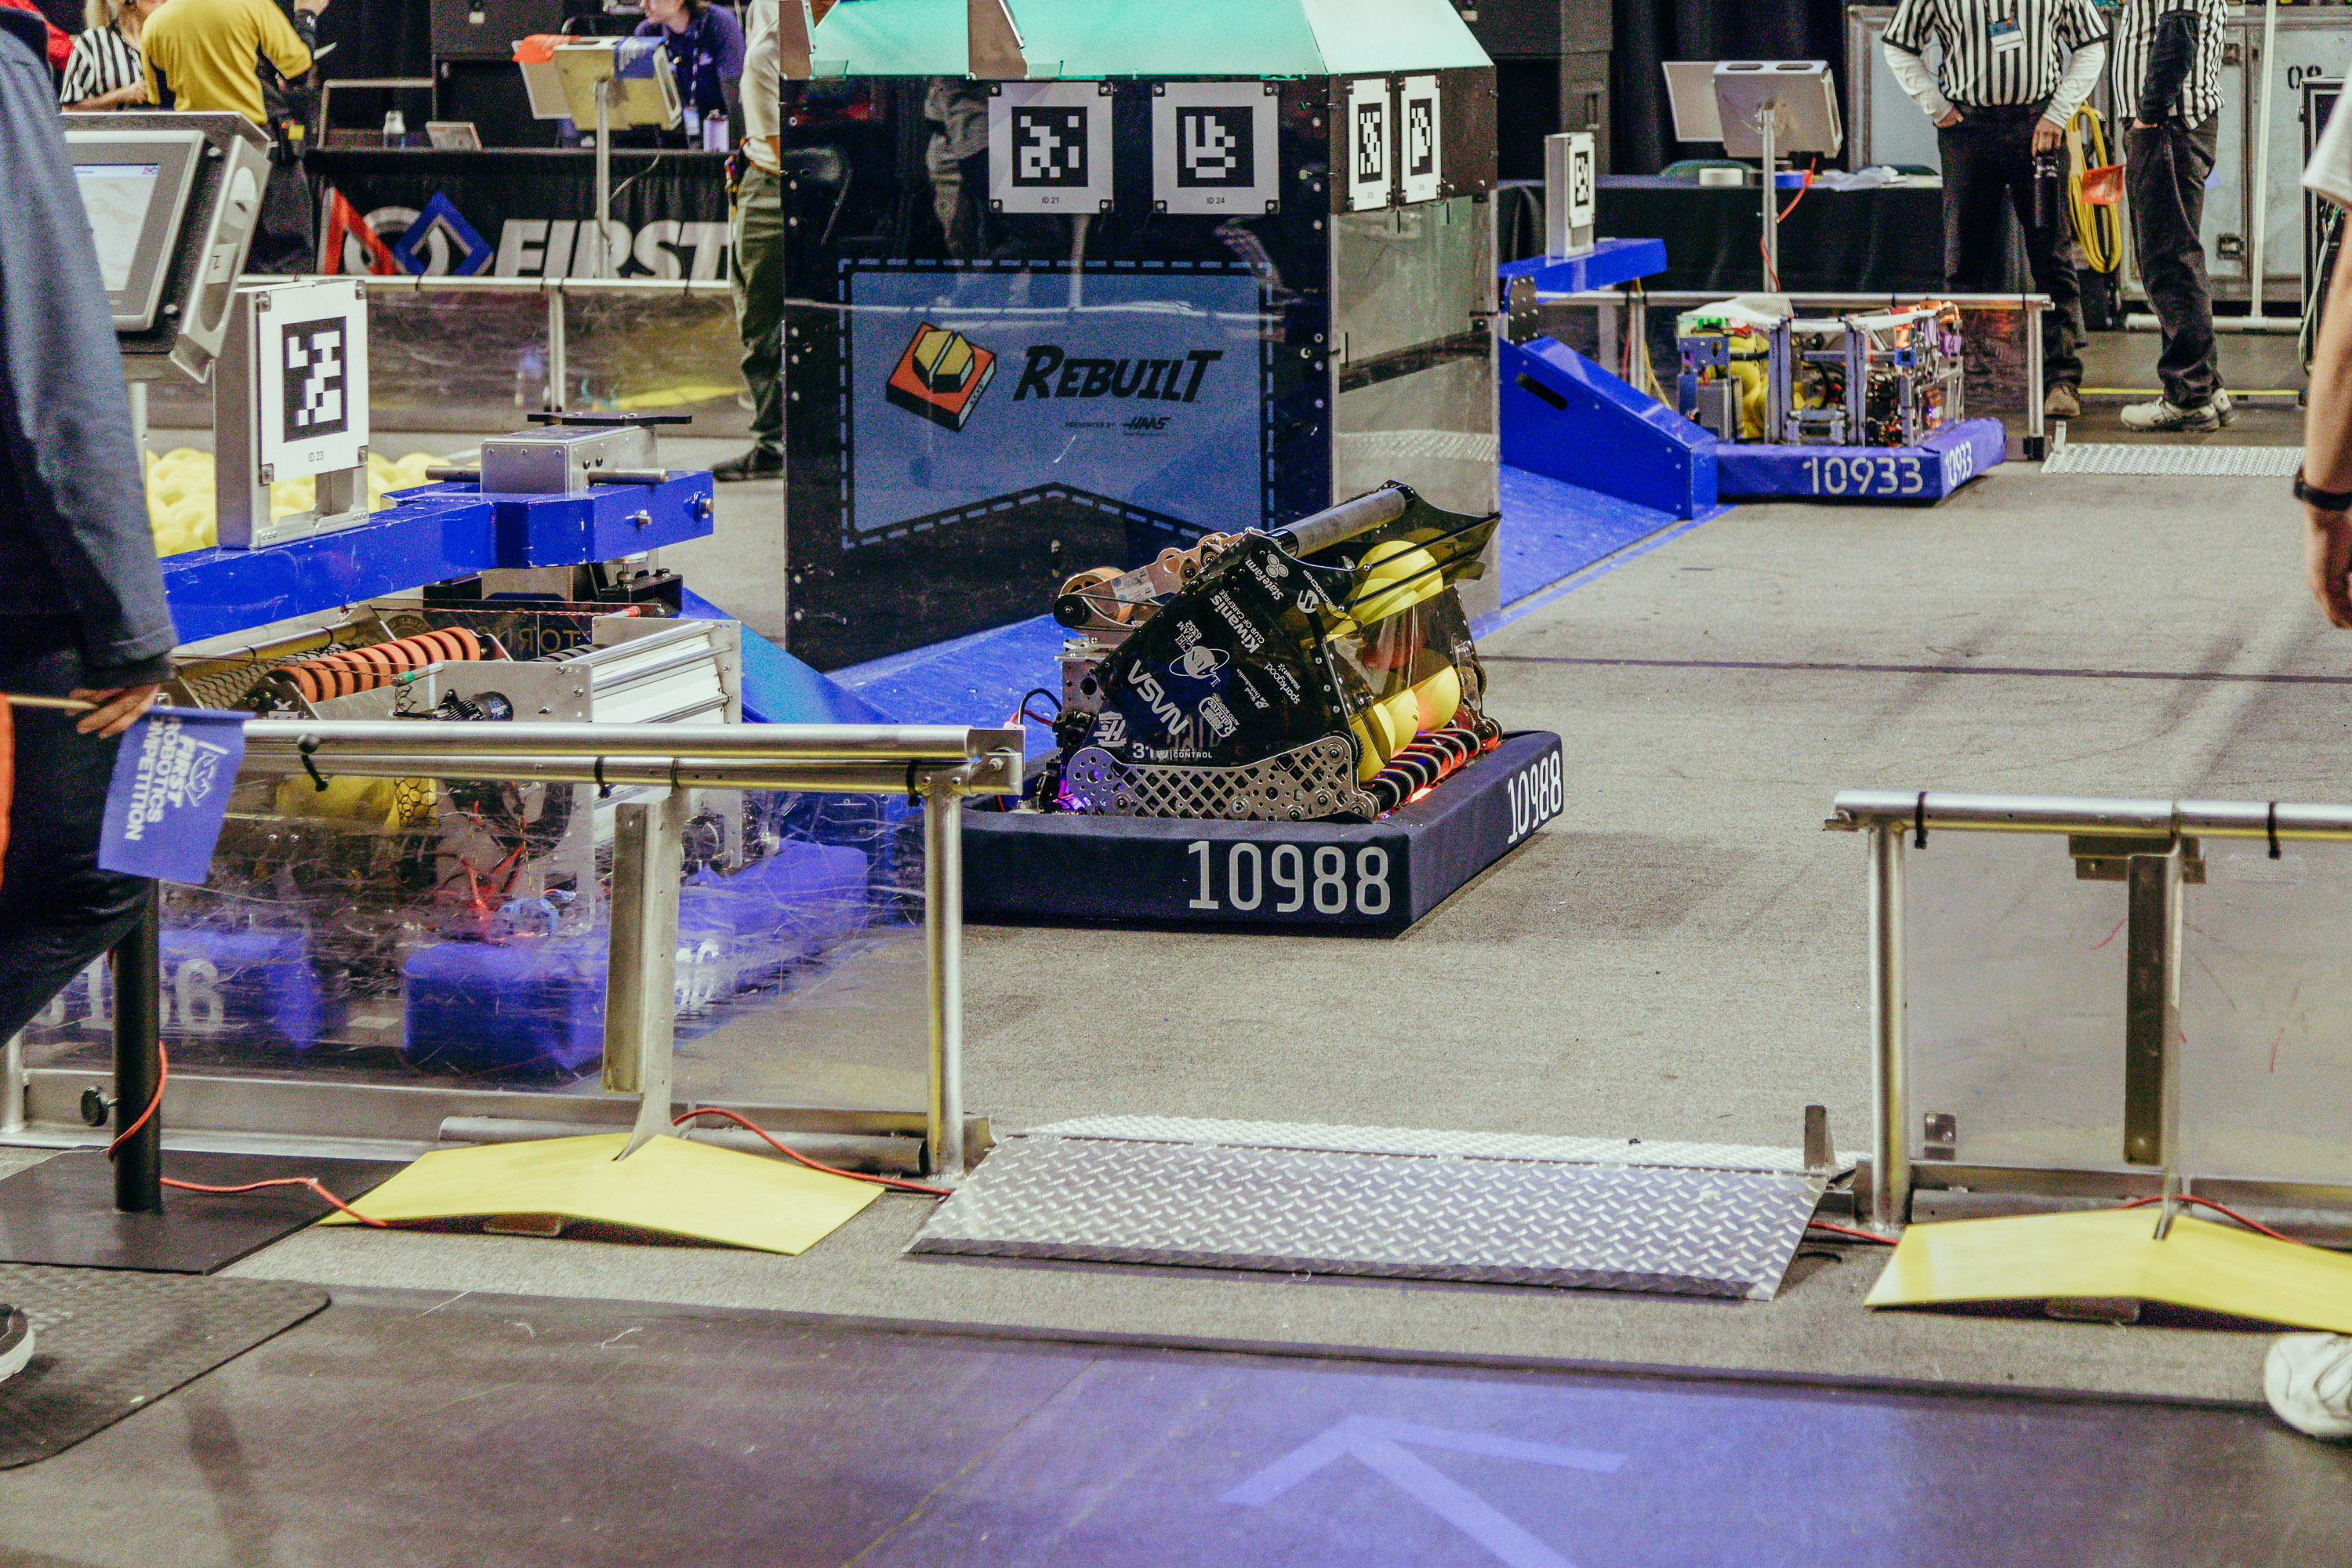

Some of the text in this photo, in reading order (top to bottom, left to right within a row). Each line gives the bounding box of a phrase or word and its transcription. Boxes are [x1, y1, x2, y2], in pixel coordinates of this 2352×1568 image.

[494, 219, 730, 280] FIRST
[1012, 345, 1224, 403] REBUILT
[308, 450, 324, 462] ID 23
[1802, 456, 1924, 495] 10933
[1944, 441, 1973, 487] 10933
[1176, 621, 1198, 644] TEAM
[1185, 619, 1203, 640] 6352
[1210, 594, 1261, 654] Kiwanis
[1218, 589, 1265, 644] CLUB OF CAREFREE
[1127, 659, 1189, 735] NASA
[1207, 700, 1237, 737] Raintree
[1229, 713, 1240, 726] AUTO
[167, 735, 196, 808] FIRST
[1508, 750, 1562, 844] 10988
[1189, 840, 1391, 915] 10988
